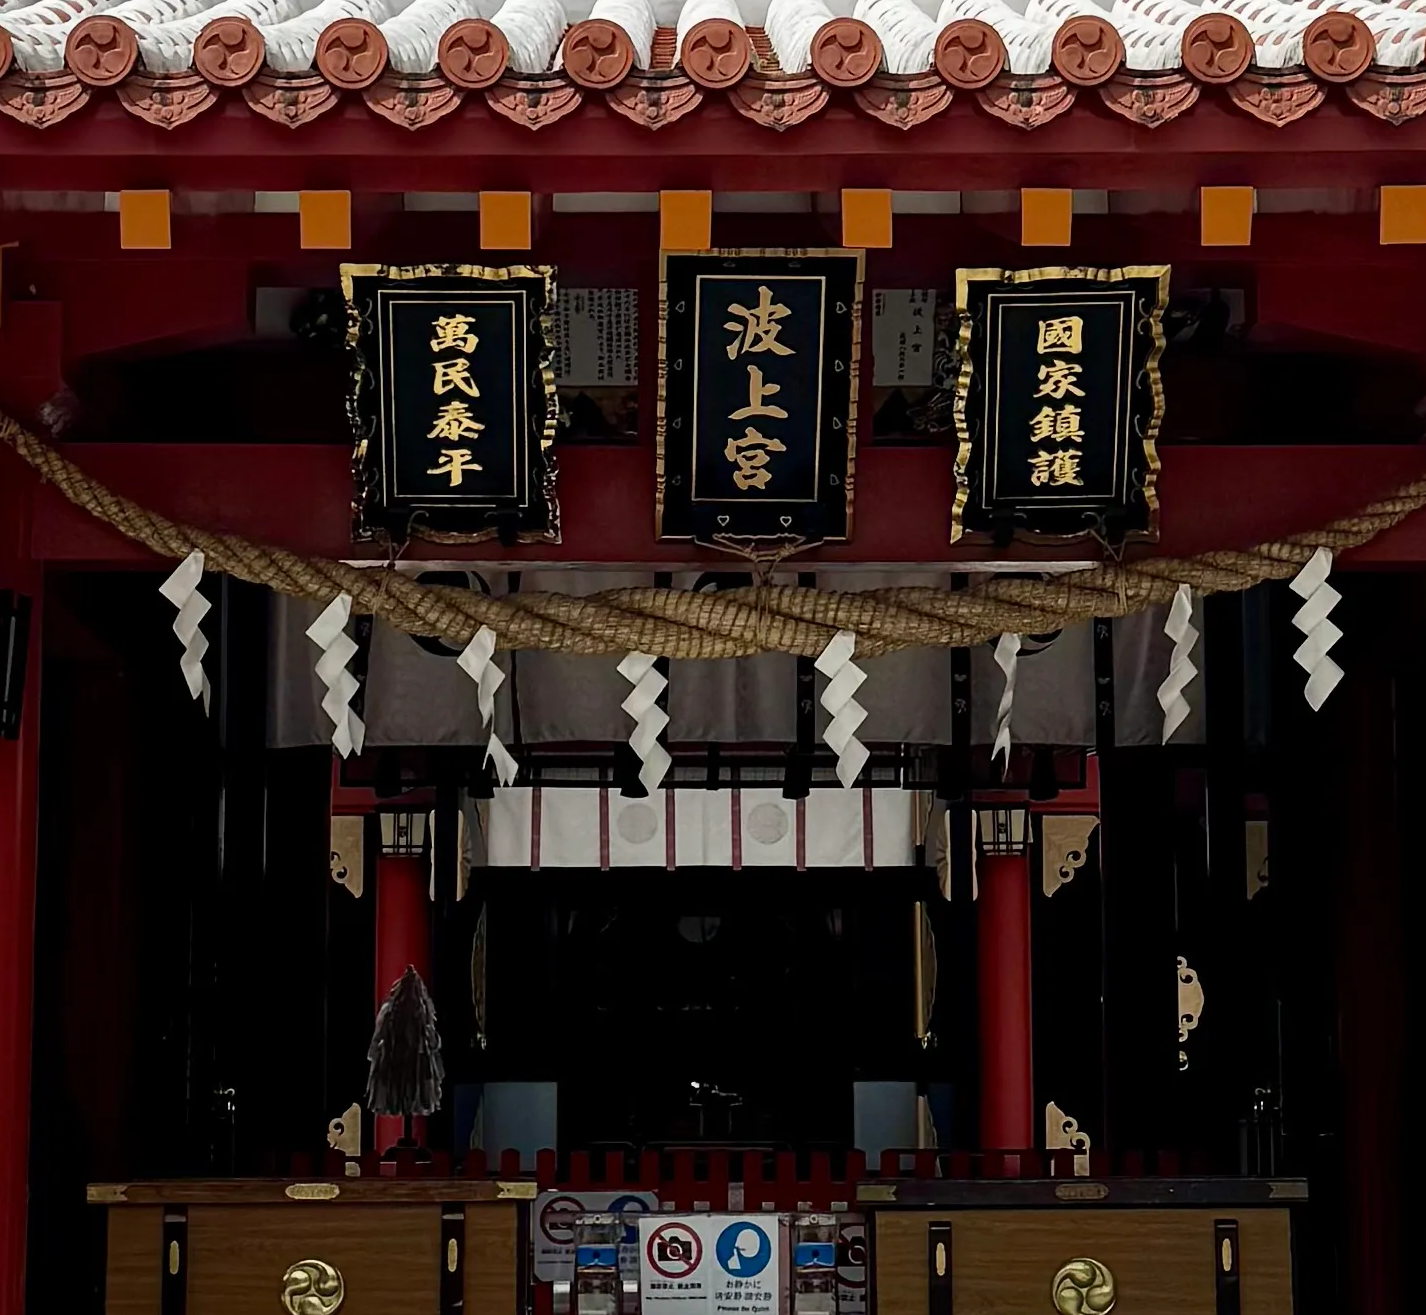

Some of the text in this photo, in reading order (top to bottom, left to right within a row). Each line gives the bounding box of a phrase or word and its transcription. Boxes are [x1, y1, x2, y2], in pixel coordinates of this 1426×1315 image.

[426, 313, 486, 487] 萬民泰平
[723, 285, 796, 491] 波上宮
[1027, 315, 1086, 487] 國家鎮護
